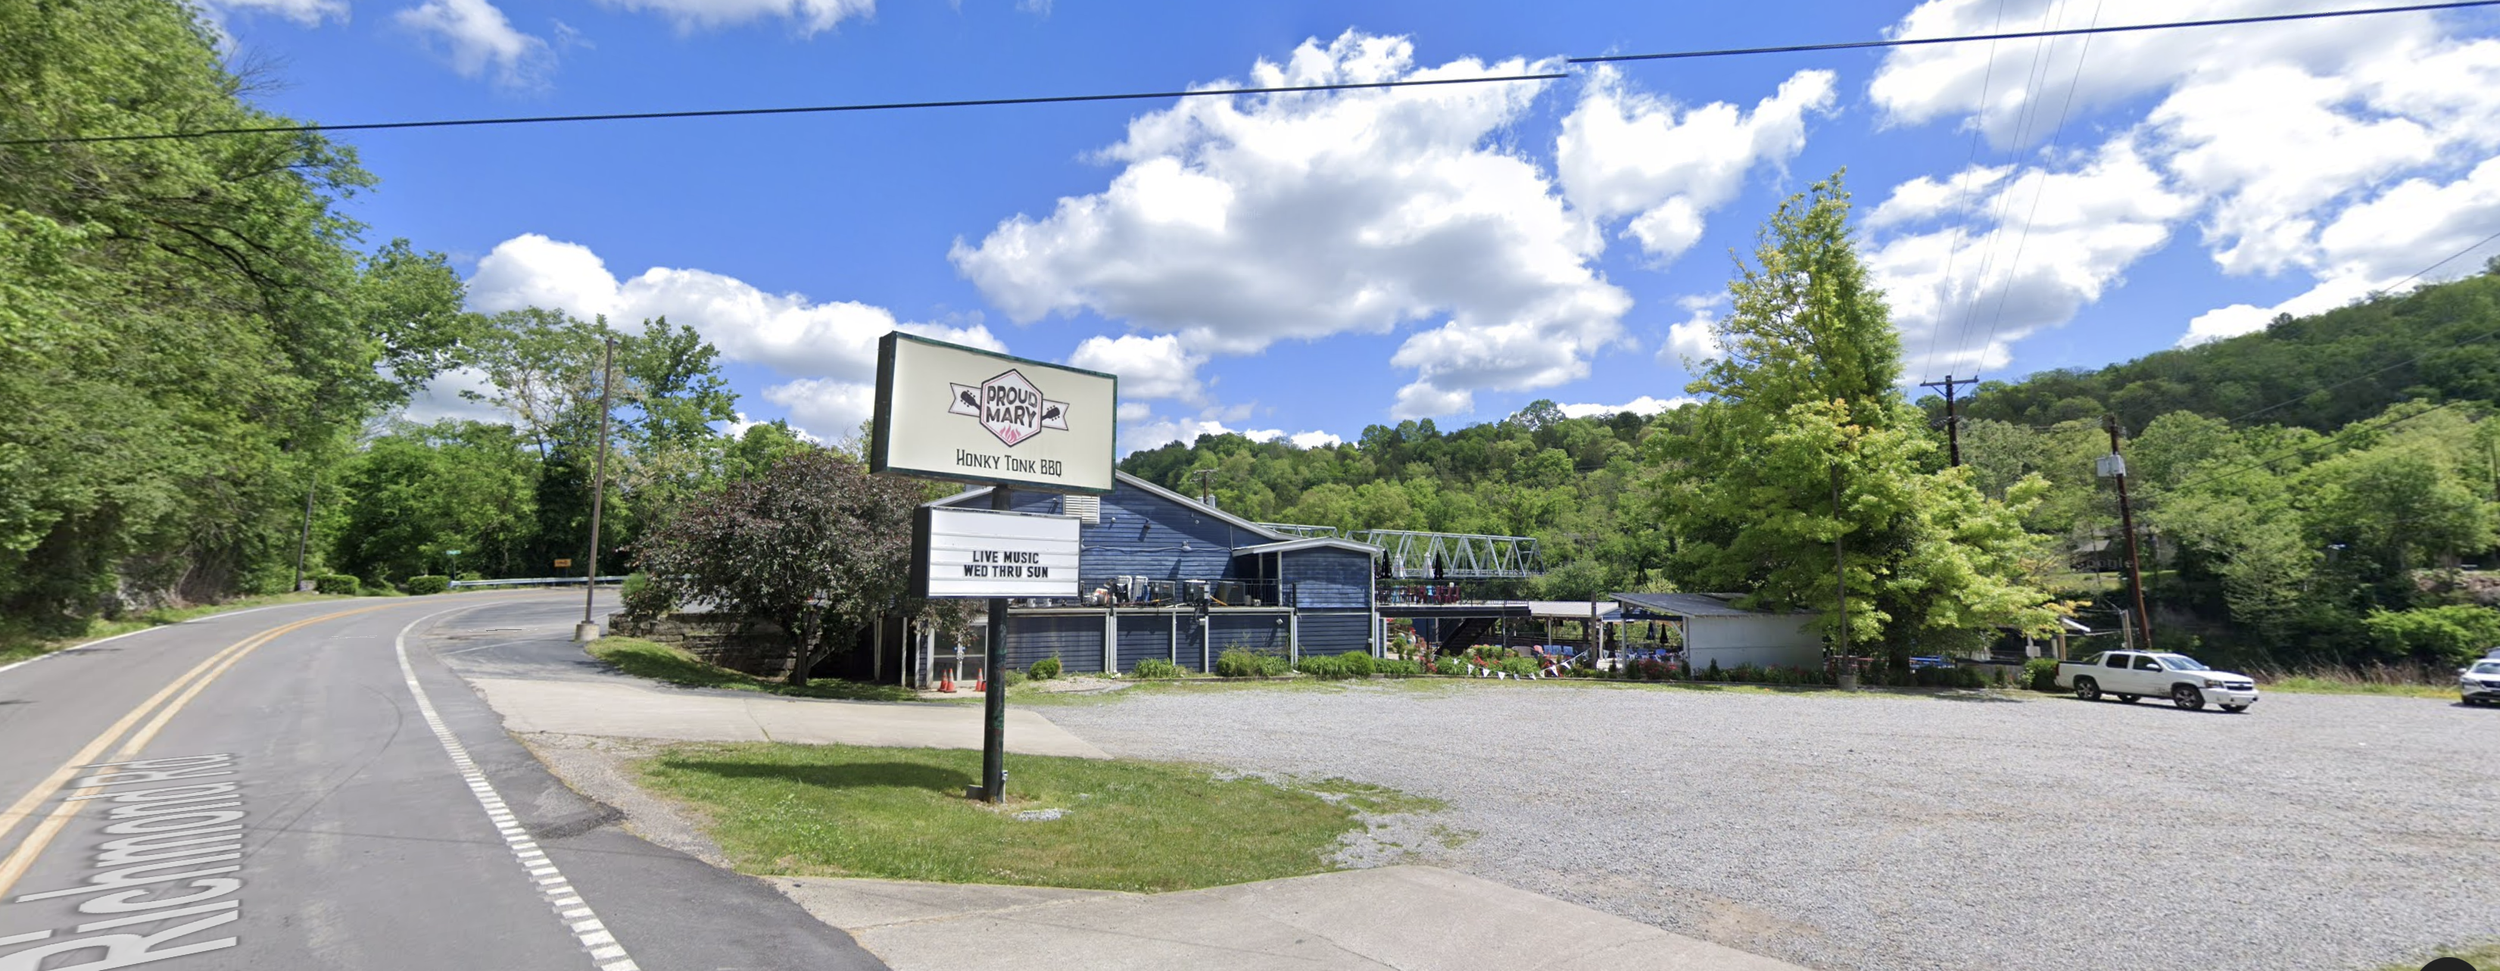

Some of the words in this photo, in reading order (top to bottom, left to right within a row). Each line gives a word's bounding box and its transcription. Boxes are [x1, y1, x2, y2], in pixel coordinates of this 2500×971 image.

[987, 385, 1038, 409] PROUD
[986, 405, 1037, 428] MARY
[956, 448, 1001, 470] HONKY
[1004, 454, 1037, 474] TONK
[1040, 458, 1063, 478] BBQ
[972, 550, 999, 563] LIVE
[1003, 551, 1040, 564] MUSIC
[964, 564, 989, 577] WED
[991, 565, 1022, 578] THRU
[1026, 566, 1049, 578] SUN
